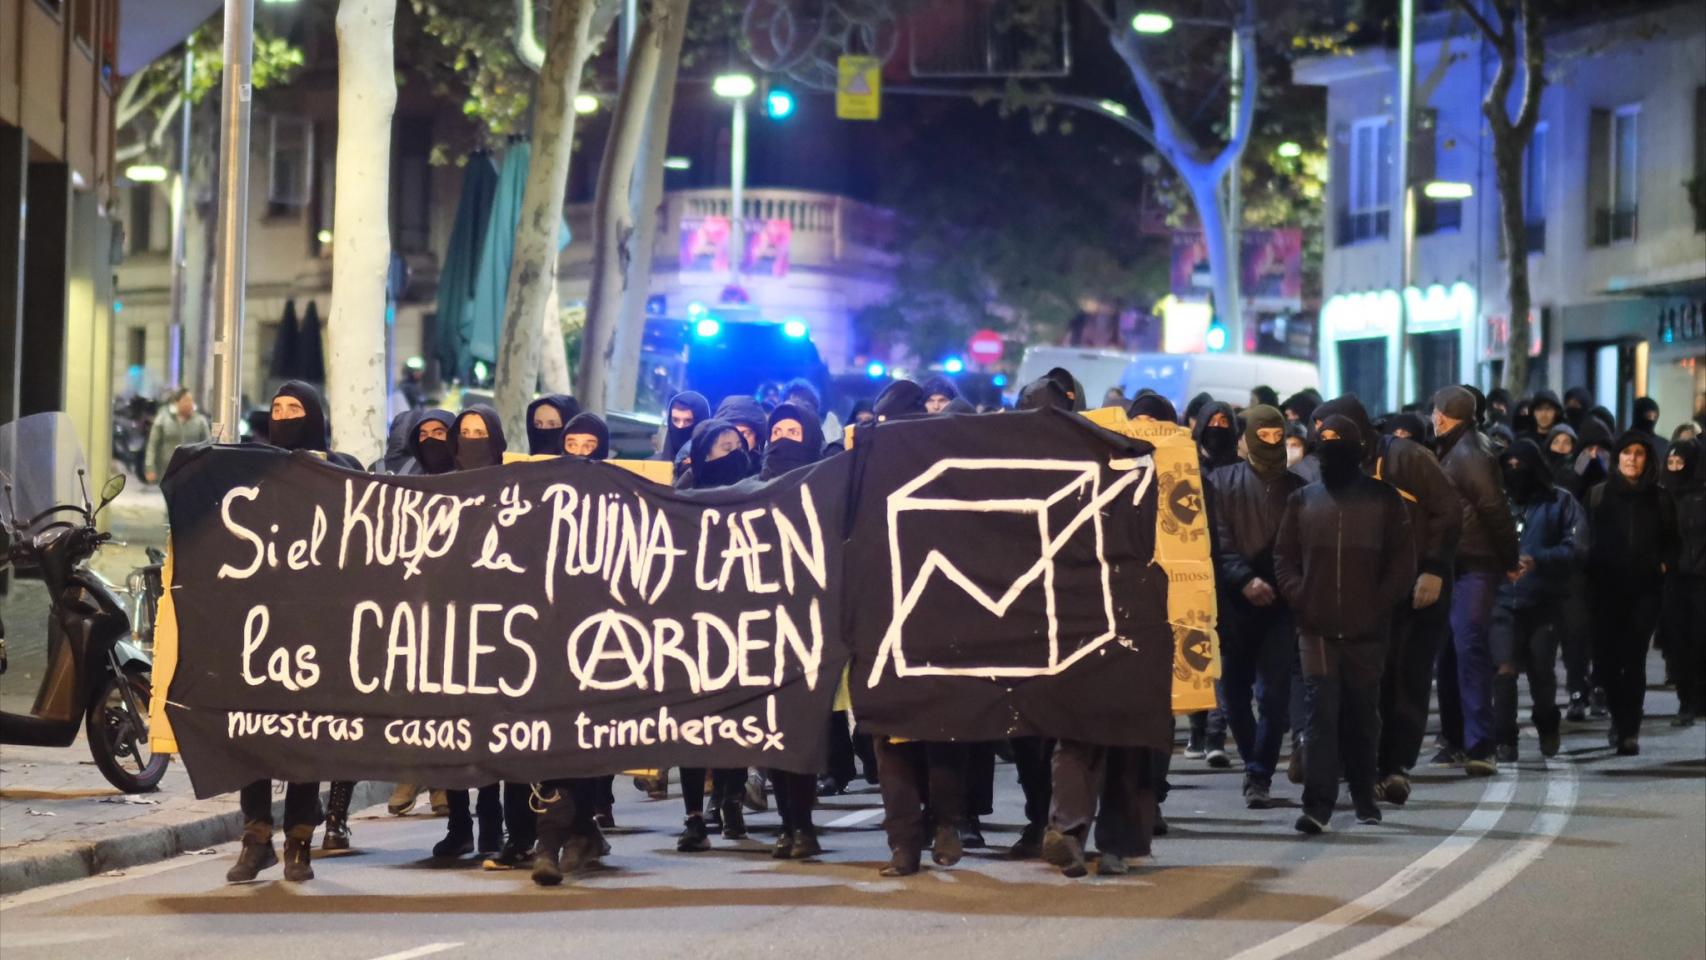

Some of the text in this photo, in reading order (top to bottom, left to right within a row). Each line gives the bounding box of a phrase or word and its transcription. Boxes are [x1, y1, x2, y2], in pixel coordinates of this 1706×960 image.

[498, 483, 533, 528] y
[471, 523, 526, 574] la
[694, 483, 827, 596] CAEN
[241, 597, 824, 698] las CALLES ARDEN
[227, 694, 785, 754] nuestras casas son trincheras!
